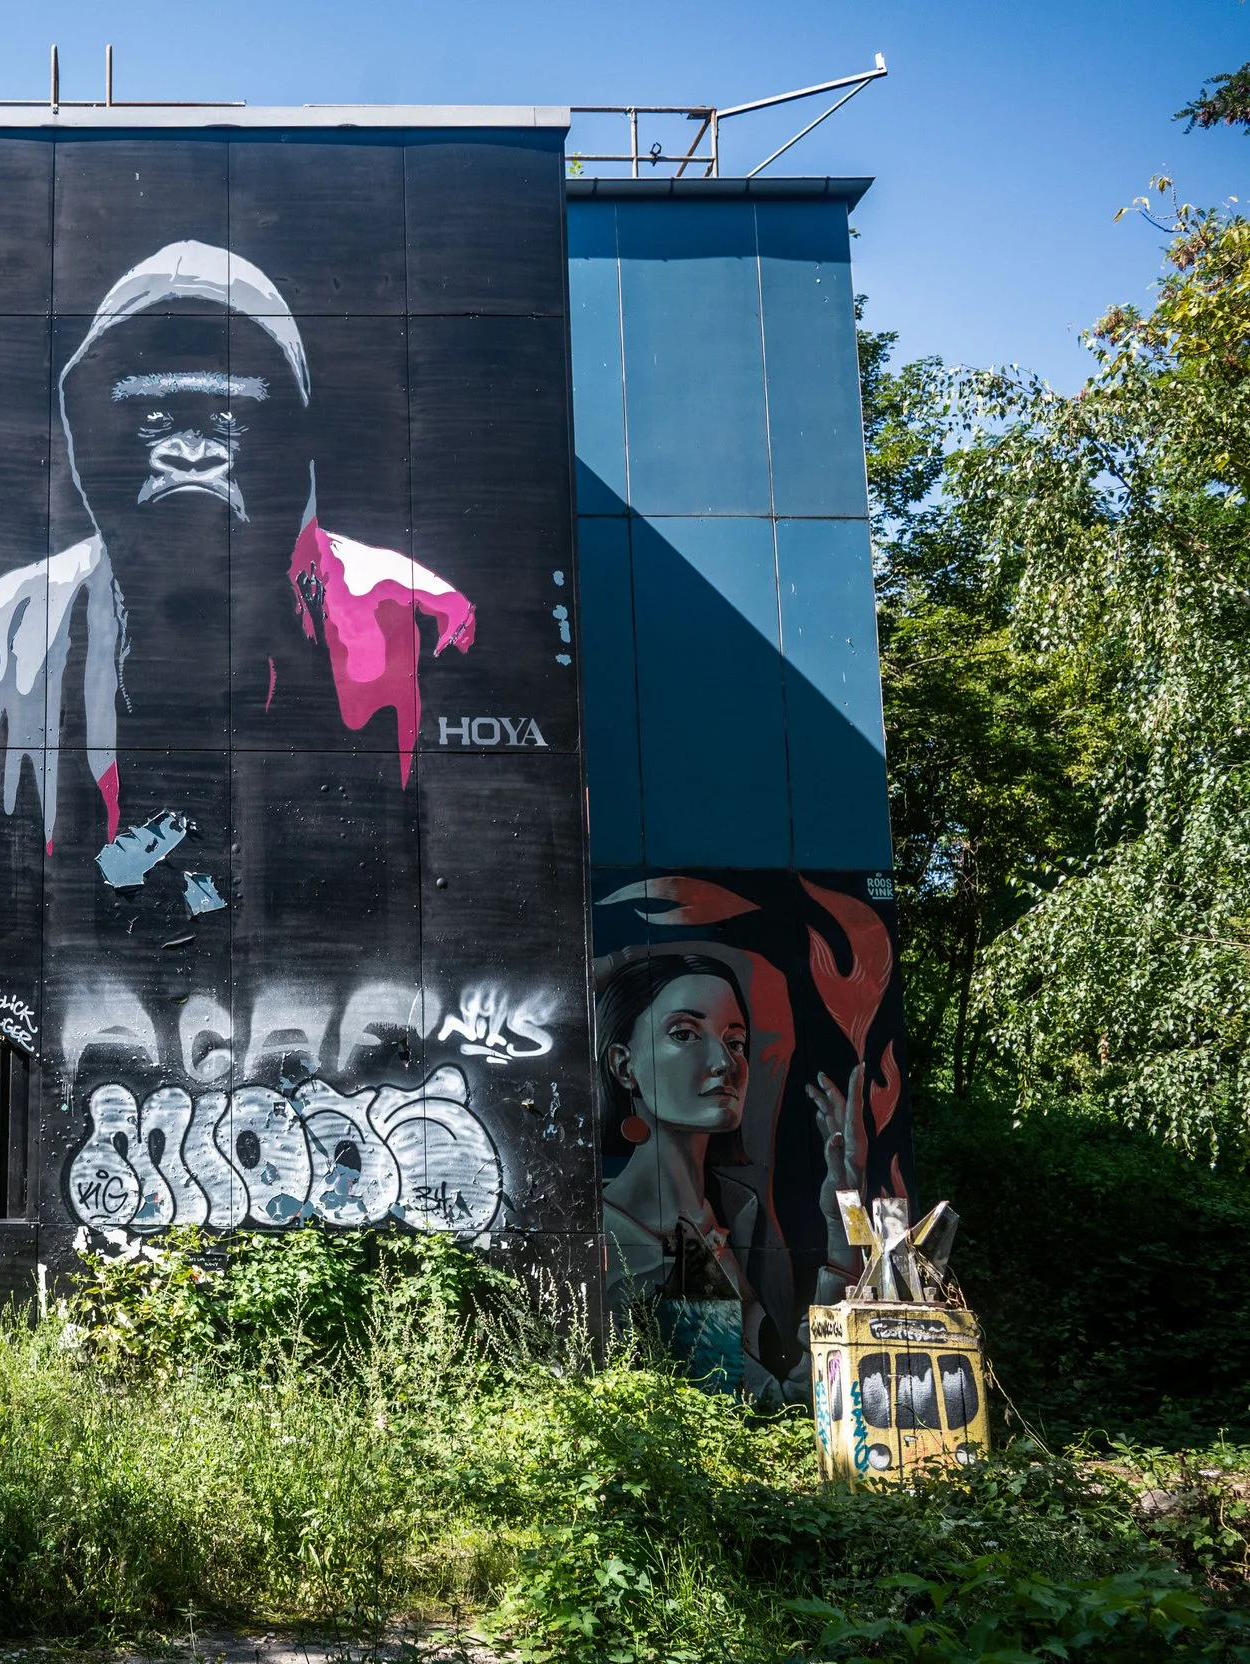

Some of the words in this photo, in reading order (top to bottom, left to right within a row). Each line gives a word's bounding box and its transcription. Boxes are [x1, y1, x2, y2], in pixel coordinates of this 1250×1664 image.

[438, 716, 549, 746] HOYA
[866, 877, 893, 888] ROOS
[867, 887, 894, 897] VINK
